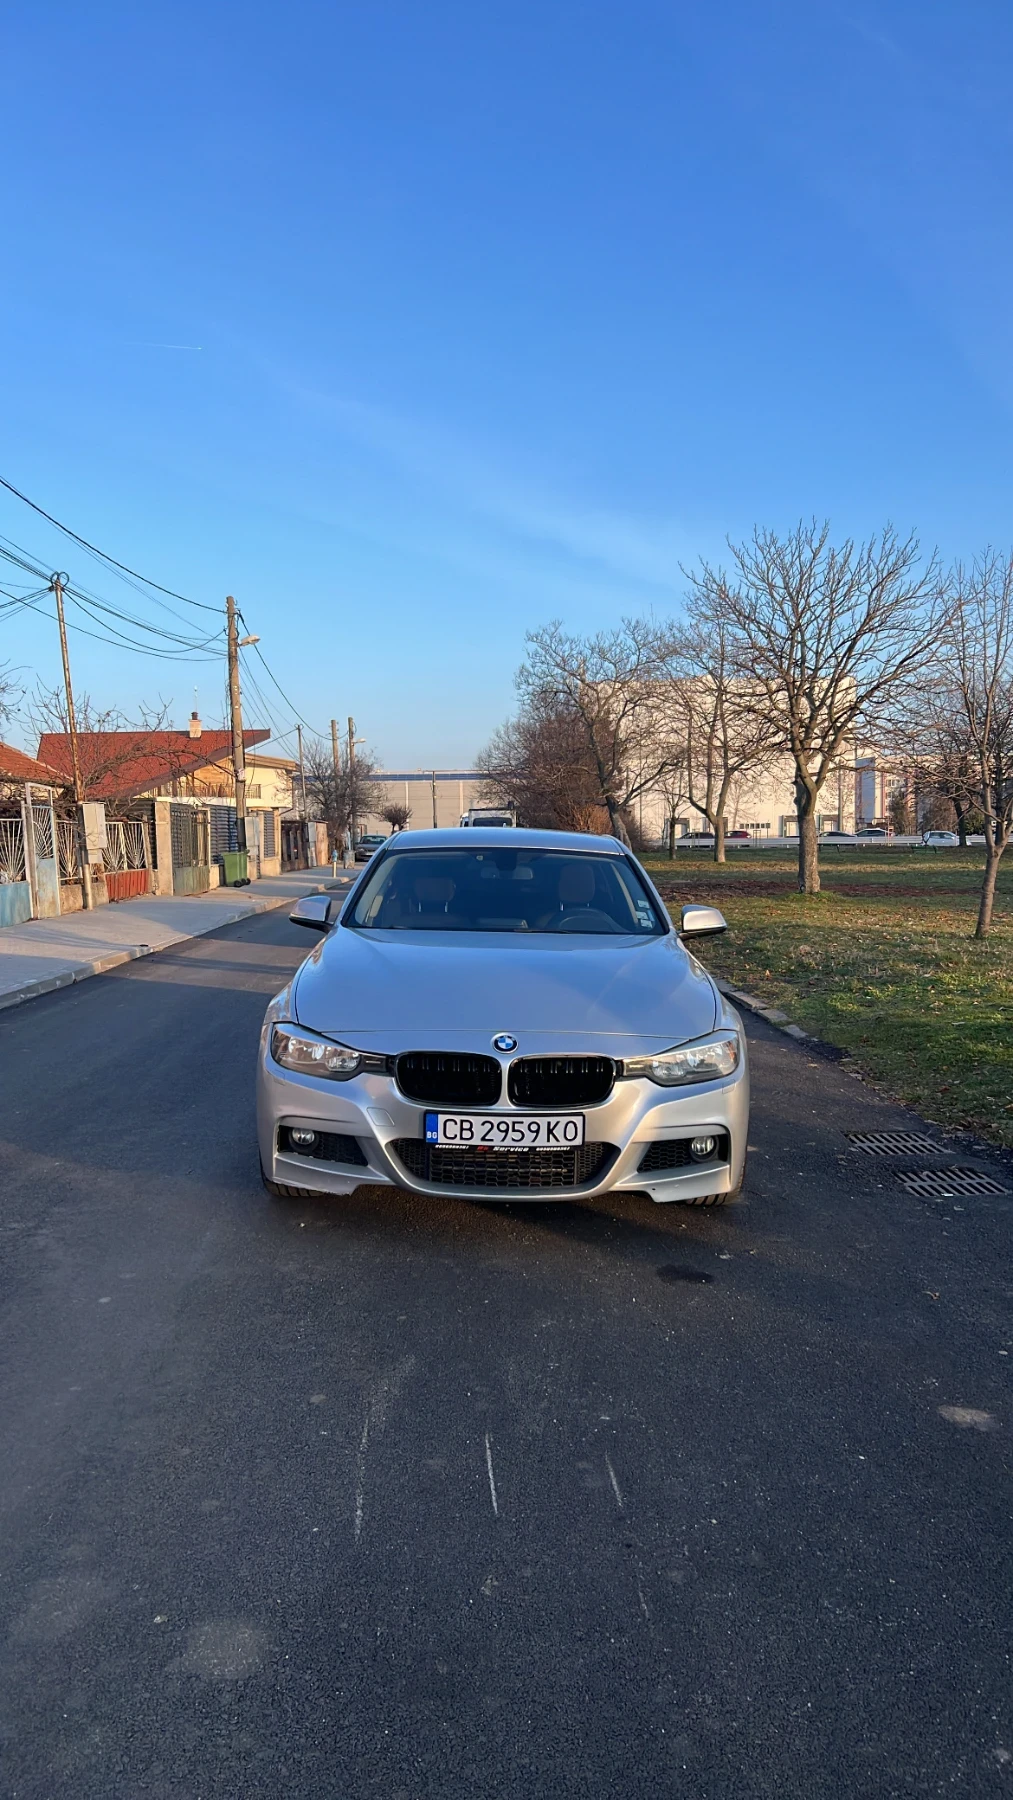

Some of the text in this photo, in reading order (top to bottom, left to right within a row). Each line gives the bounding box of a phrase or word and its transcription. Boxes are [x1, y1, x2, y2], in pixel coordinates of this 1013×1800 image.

[426, 1131, 438, 1139] BG
[442, 1118, 475, 1141] CB
[480, 1120, 541, 1143] 2959
